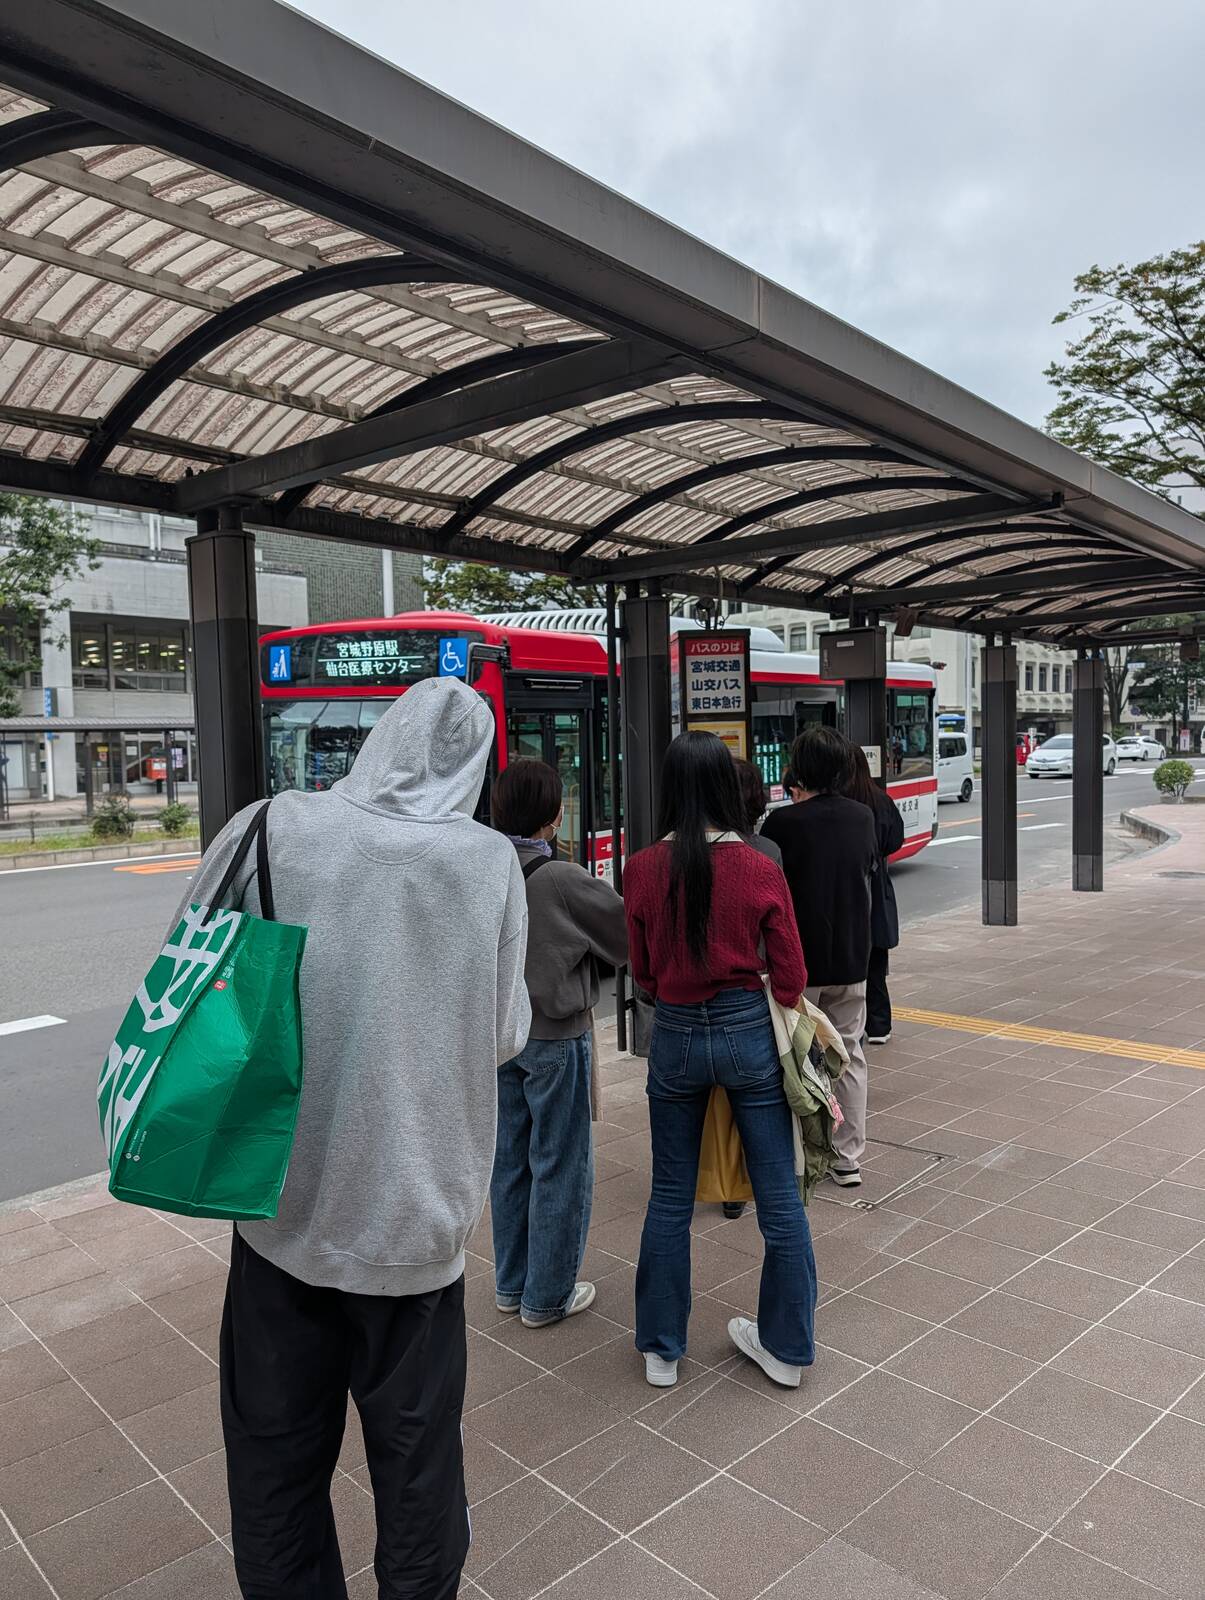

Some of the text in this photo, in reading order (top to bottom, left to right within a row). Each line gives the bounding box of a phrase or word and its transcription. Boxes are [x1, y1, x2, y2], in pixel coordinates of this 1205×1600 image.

[336, 640, 399, 658] 宮城野原駅
[690, 641, 740, 653] バスのりば
[325, 659, 422, 677] 仙台医療センター
[690, 659, 741, 673] 宮城交通
[691, 678, 741, 691] 山交バス
[691, 695, 741, 710] 東日本急行
